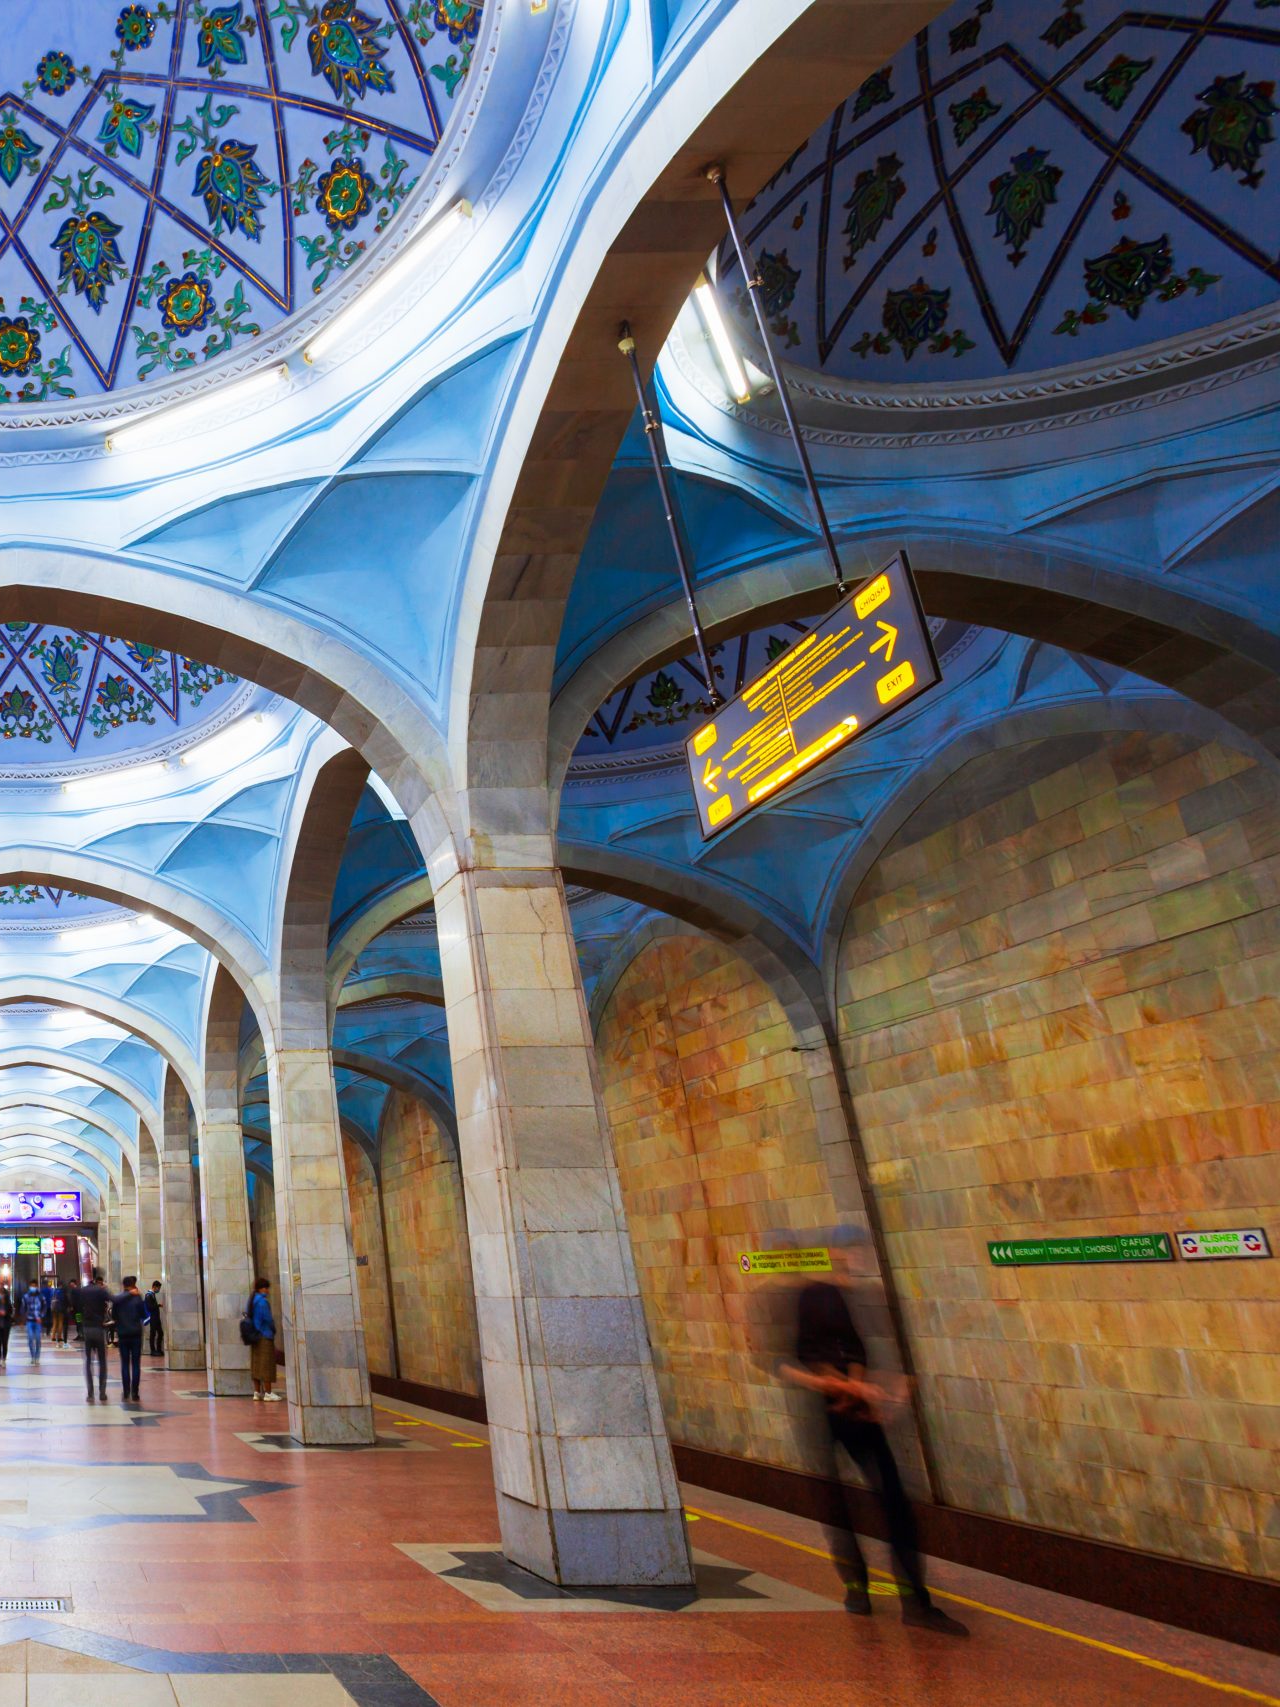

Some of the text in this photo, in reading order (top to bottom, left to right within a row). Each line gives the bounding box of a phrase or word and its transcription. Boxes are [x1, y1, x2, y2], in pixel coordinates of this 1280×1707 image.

[859, 584, 886, 611] CHIQISH
[886, 673, 904, 691] EXIT
[1199, 1233, 1240, 1244] ALISHER
[1014, 1244, 1118, 1256] BERUNIY TINCHLIK CHORSU
[1204, 1244, 1239, 1255] NAVOIY
